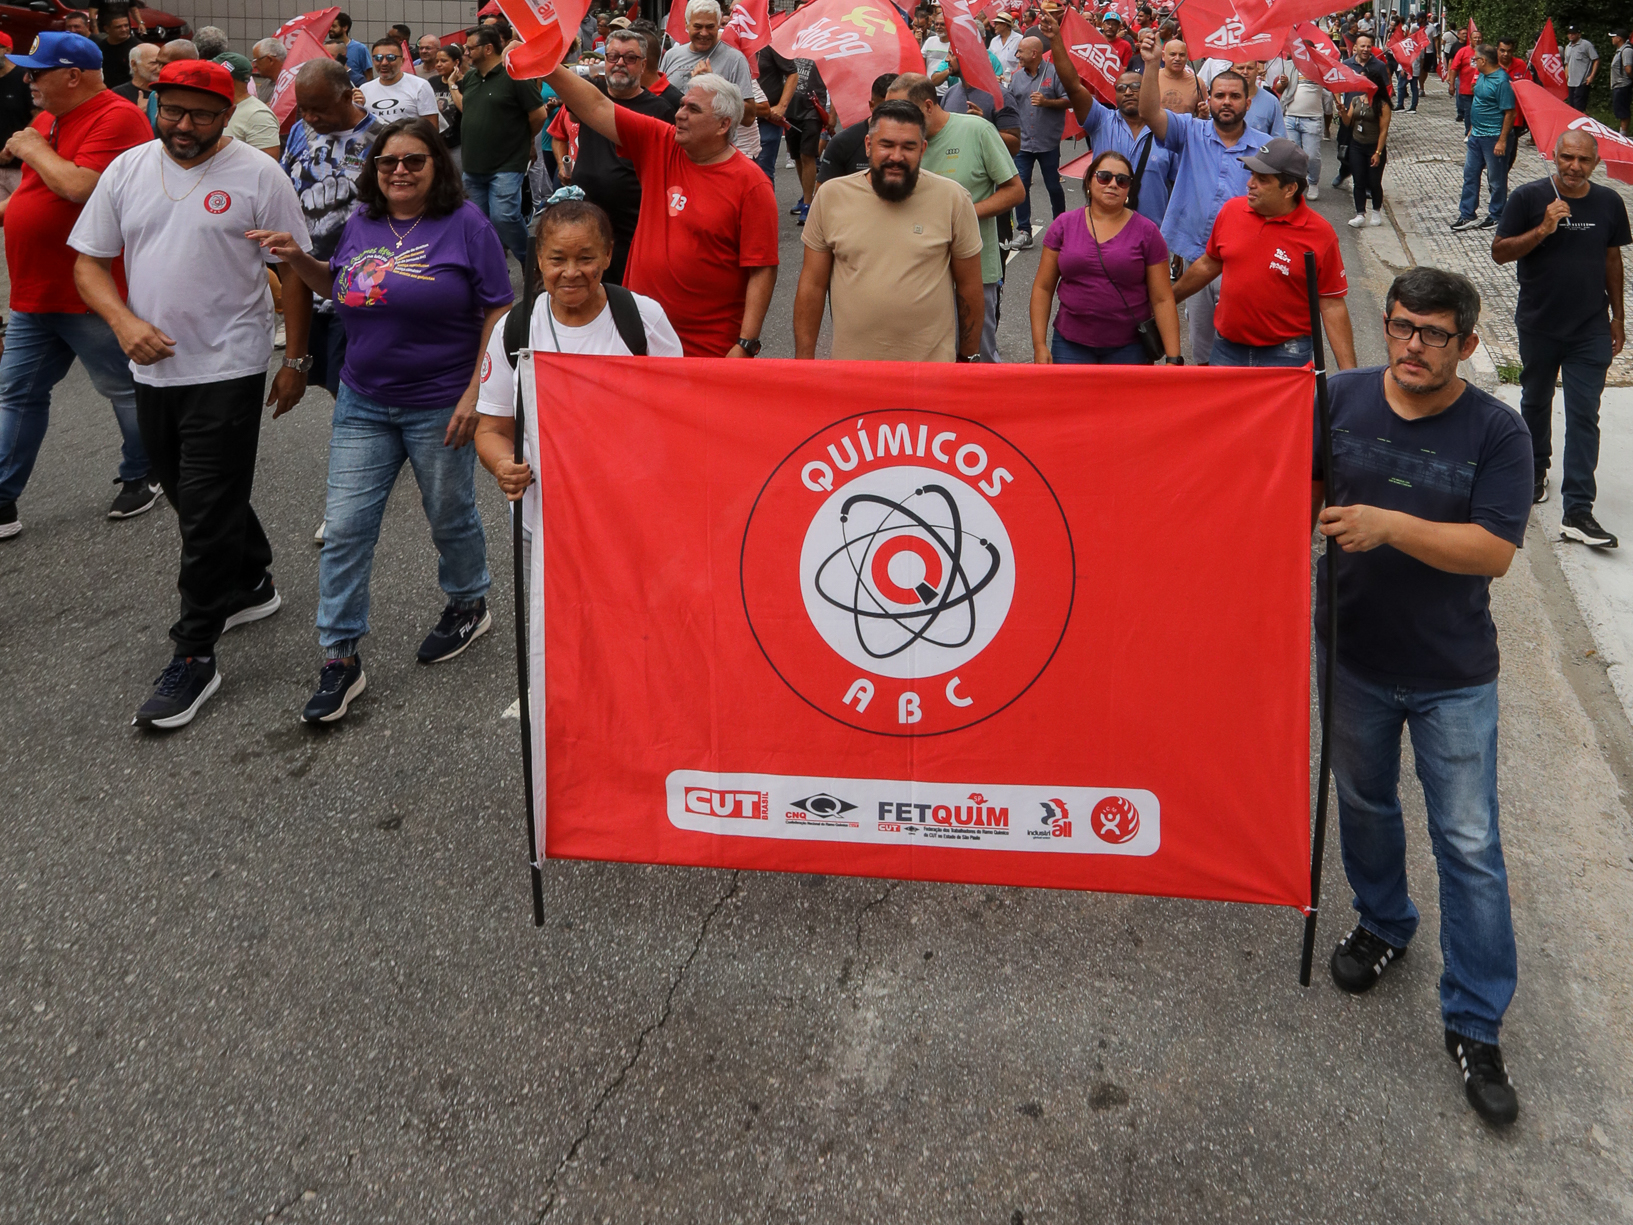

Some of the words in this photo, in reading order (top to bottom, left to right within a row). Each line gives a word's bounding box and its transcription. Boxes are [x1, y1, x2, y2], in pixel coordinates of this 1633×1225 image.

[670, 193, 687, 211] 13
[801, 419, 1014, 497] QUÍMICOS
[686, 789, 759, 818] CUT
[785, 811, 806, 820] CNQ
[878, 801, 1009, 828] FETQUIM
